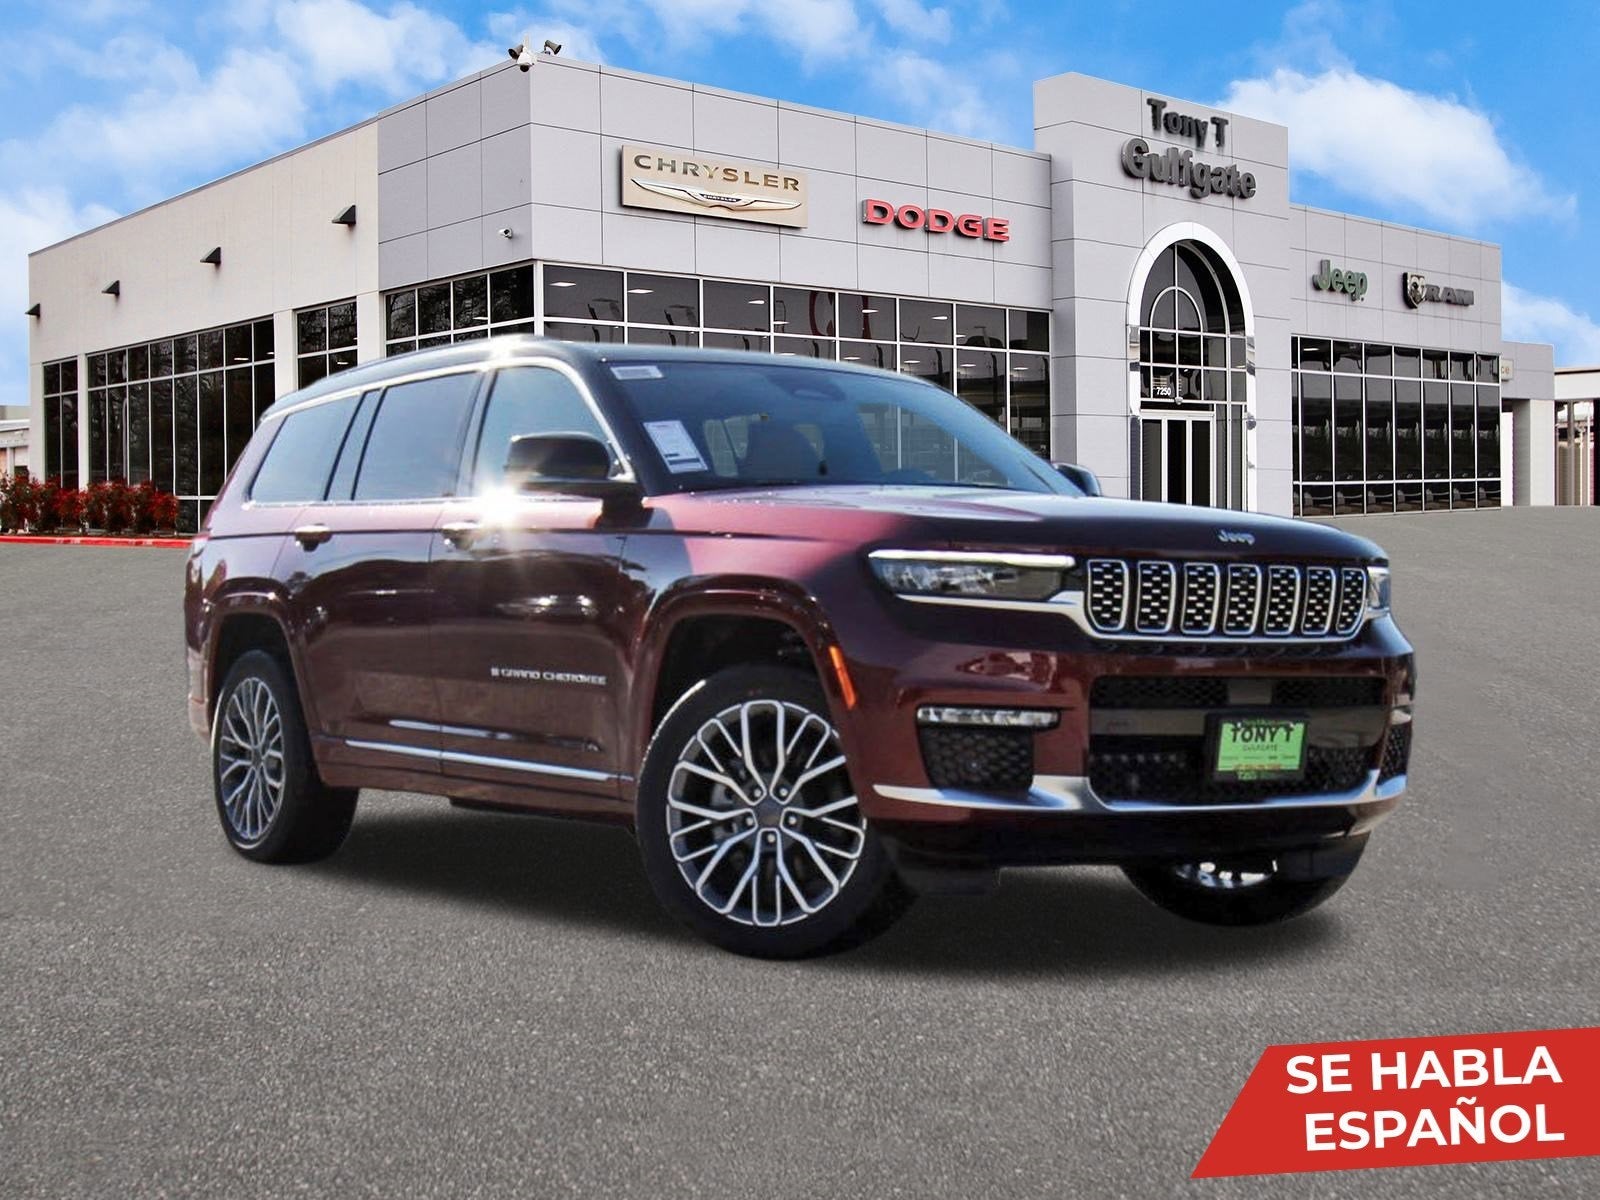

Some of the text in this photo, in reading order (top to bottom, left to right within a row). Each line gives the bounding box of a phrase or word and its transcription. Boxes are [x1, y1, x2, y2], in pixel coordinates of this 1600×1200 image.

[1147, 98, 1229, 147] Tony T
[633, 153, 801, 192] CHRYSLER
[1121, 137, 1256, 199] Gulfgate
[862, 198, 1010, 242] DODGE
[1312, 259, 1368, 301] Jeep
[1424, 283, 1475, 306] RAM
[1217, 529, 1256, 546] Jeep
[501, 668, 607, 685] GRAND CHEROKEE
[1230, 725, 1295, 743] TONY T
